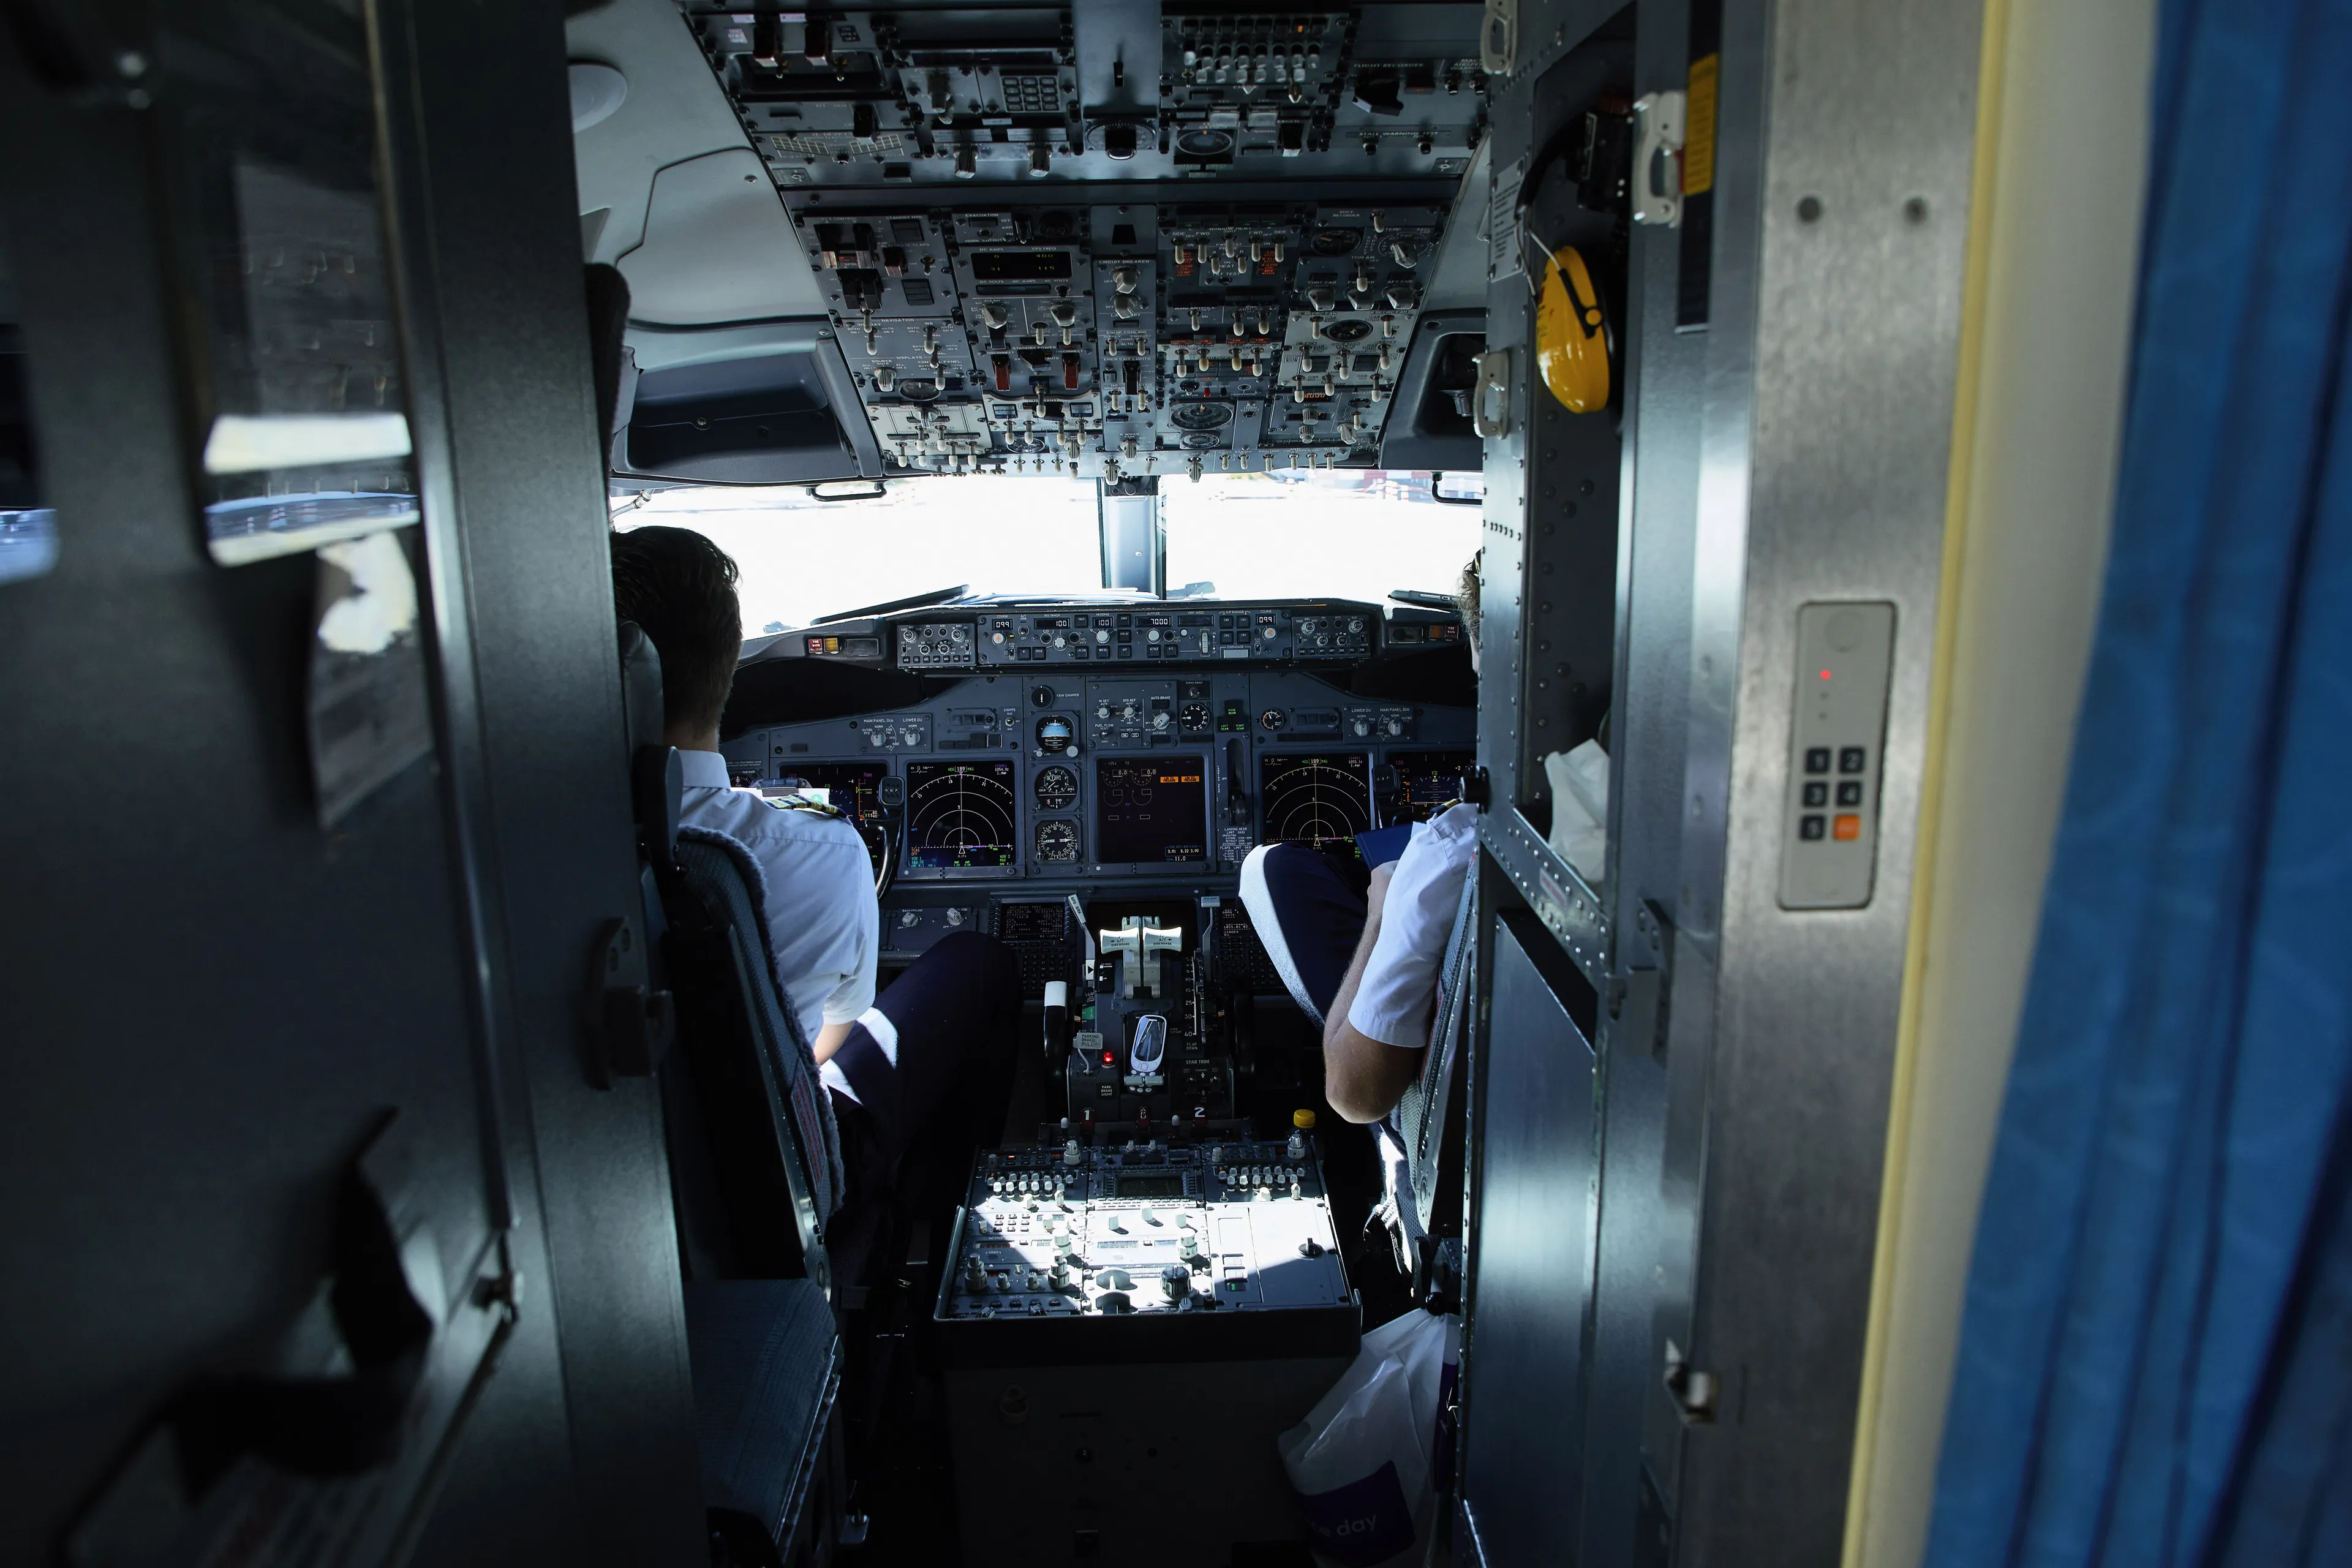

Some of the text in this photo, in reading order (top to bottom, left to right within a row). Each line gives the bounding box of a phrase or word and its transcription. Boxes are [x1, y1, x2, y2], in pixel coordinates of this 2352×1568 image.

[1814, 752, 1861, 771] 1 2
[1810, 786, 1857, 804] 3 4
[1084, 1110, 1090, 1120] 1
[1194, 1107, 1205, 1118] 2
[1336, 1513, 1377, 1536] day
